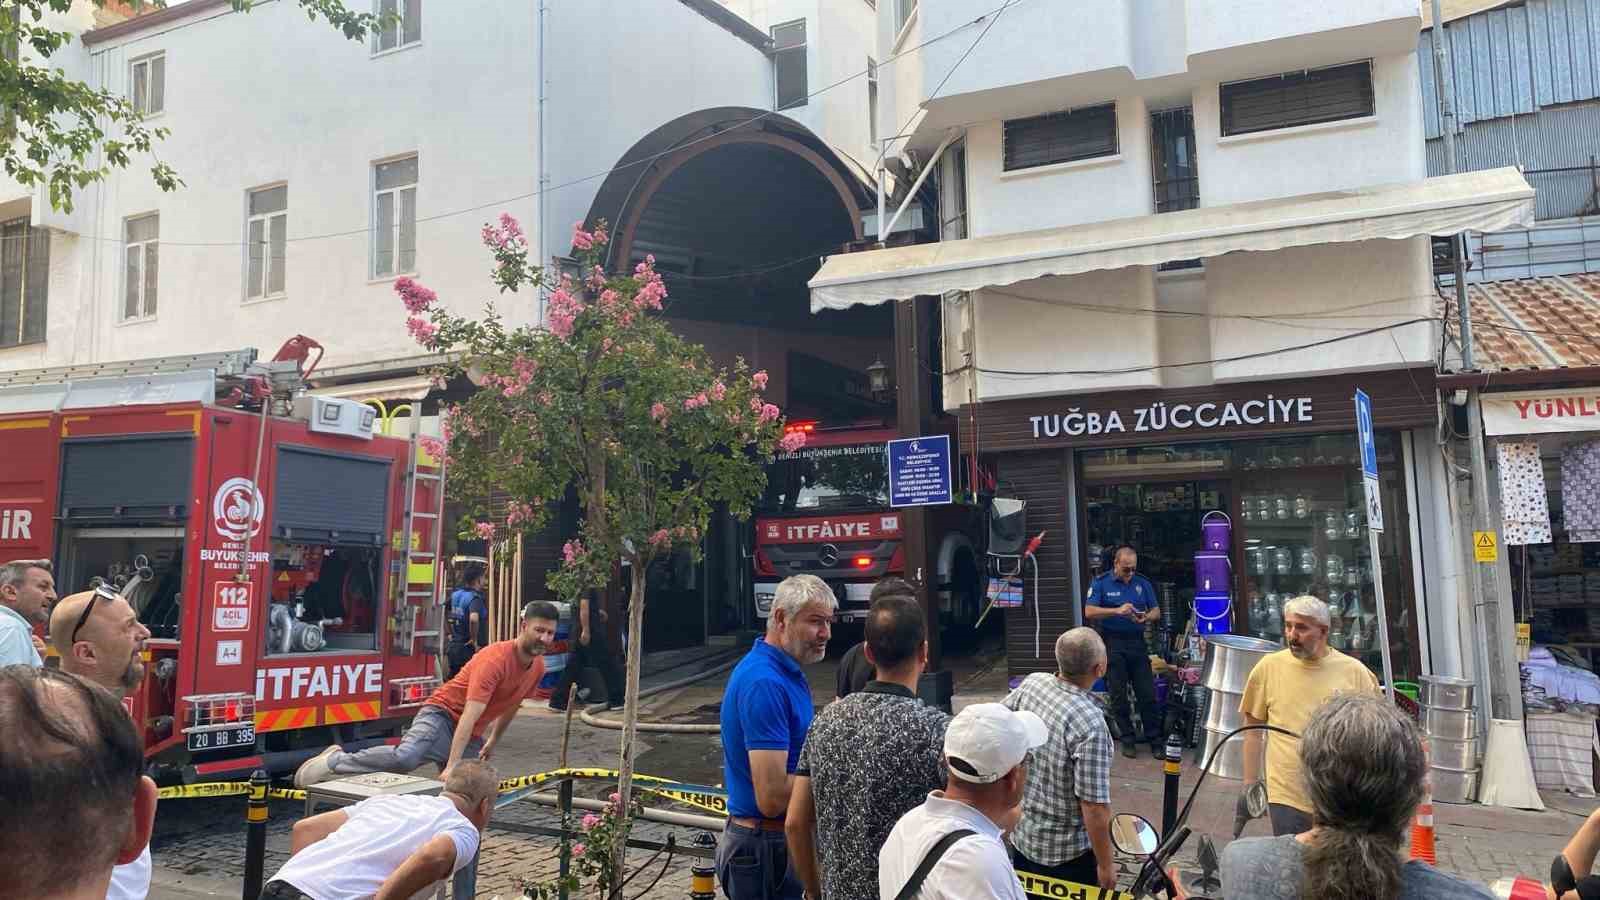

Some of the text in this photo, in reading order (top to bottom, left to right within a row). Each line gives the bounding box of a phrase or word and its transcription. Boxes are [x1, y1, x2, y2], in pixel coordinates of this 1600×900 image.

[1029, 394, 1313, 438] TUĞBA ZÜCCACİYE
[1513, 396, 1600, 419] YÜNL
[219, 587, 248, 605] 112
[196, 729, 254, 748] 20 BB 395
